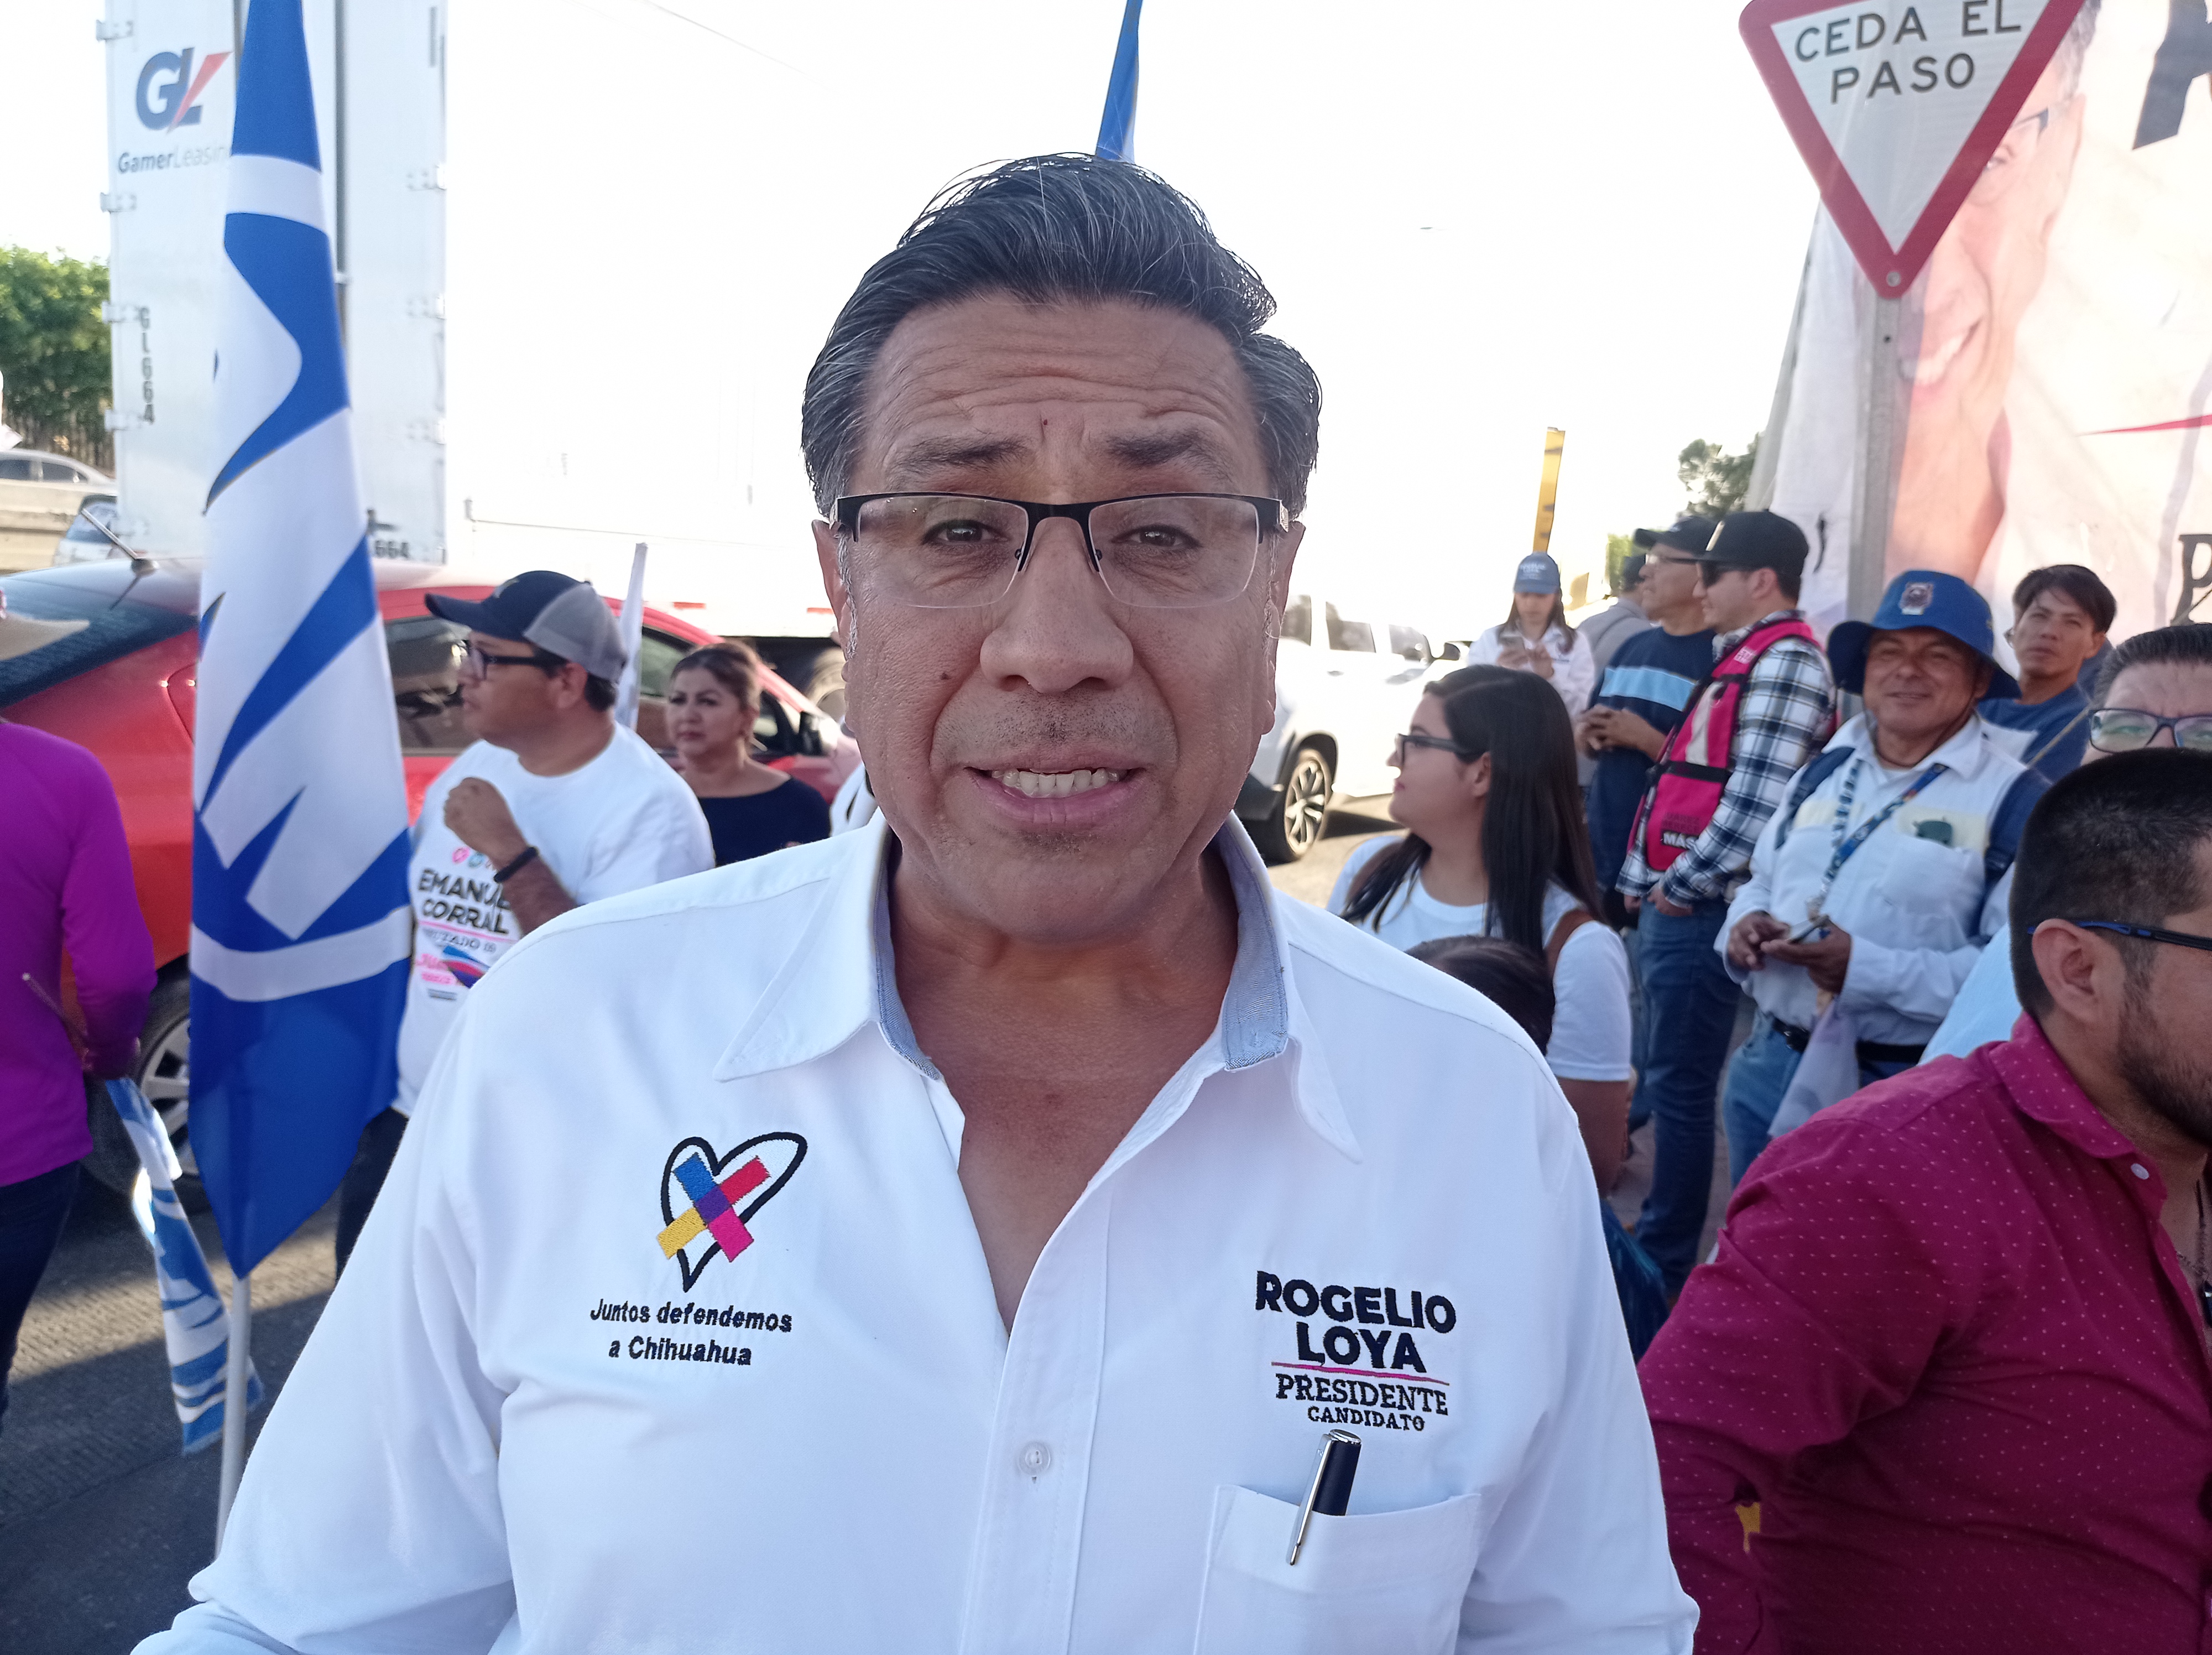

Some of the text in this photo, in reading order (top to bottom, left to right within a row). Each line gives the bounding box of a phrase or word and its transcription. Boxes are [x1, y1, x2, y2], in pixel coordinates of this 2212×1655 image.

[1795, 0, 2021, 63] CEDA EL
[1830, 53, 1975, 104] PASO
[117, 145, 228, 174] GamerLeasin
[422, 898, 509, 934] CORRAL
[589, 1298, 792, 1333] Juntos defendemos
[1255, 1270, 1457, 1334] ROGELIO
[608, 1335, 752, 1365] a Chihuahua
[1296, 1321, 1427, 1373] LOYA
[1275, 1373, 1448, 1416] PRESIDENTE
[1307, 1406, 1425, 1432] CANDIDATO
